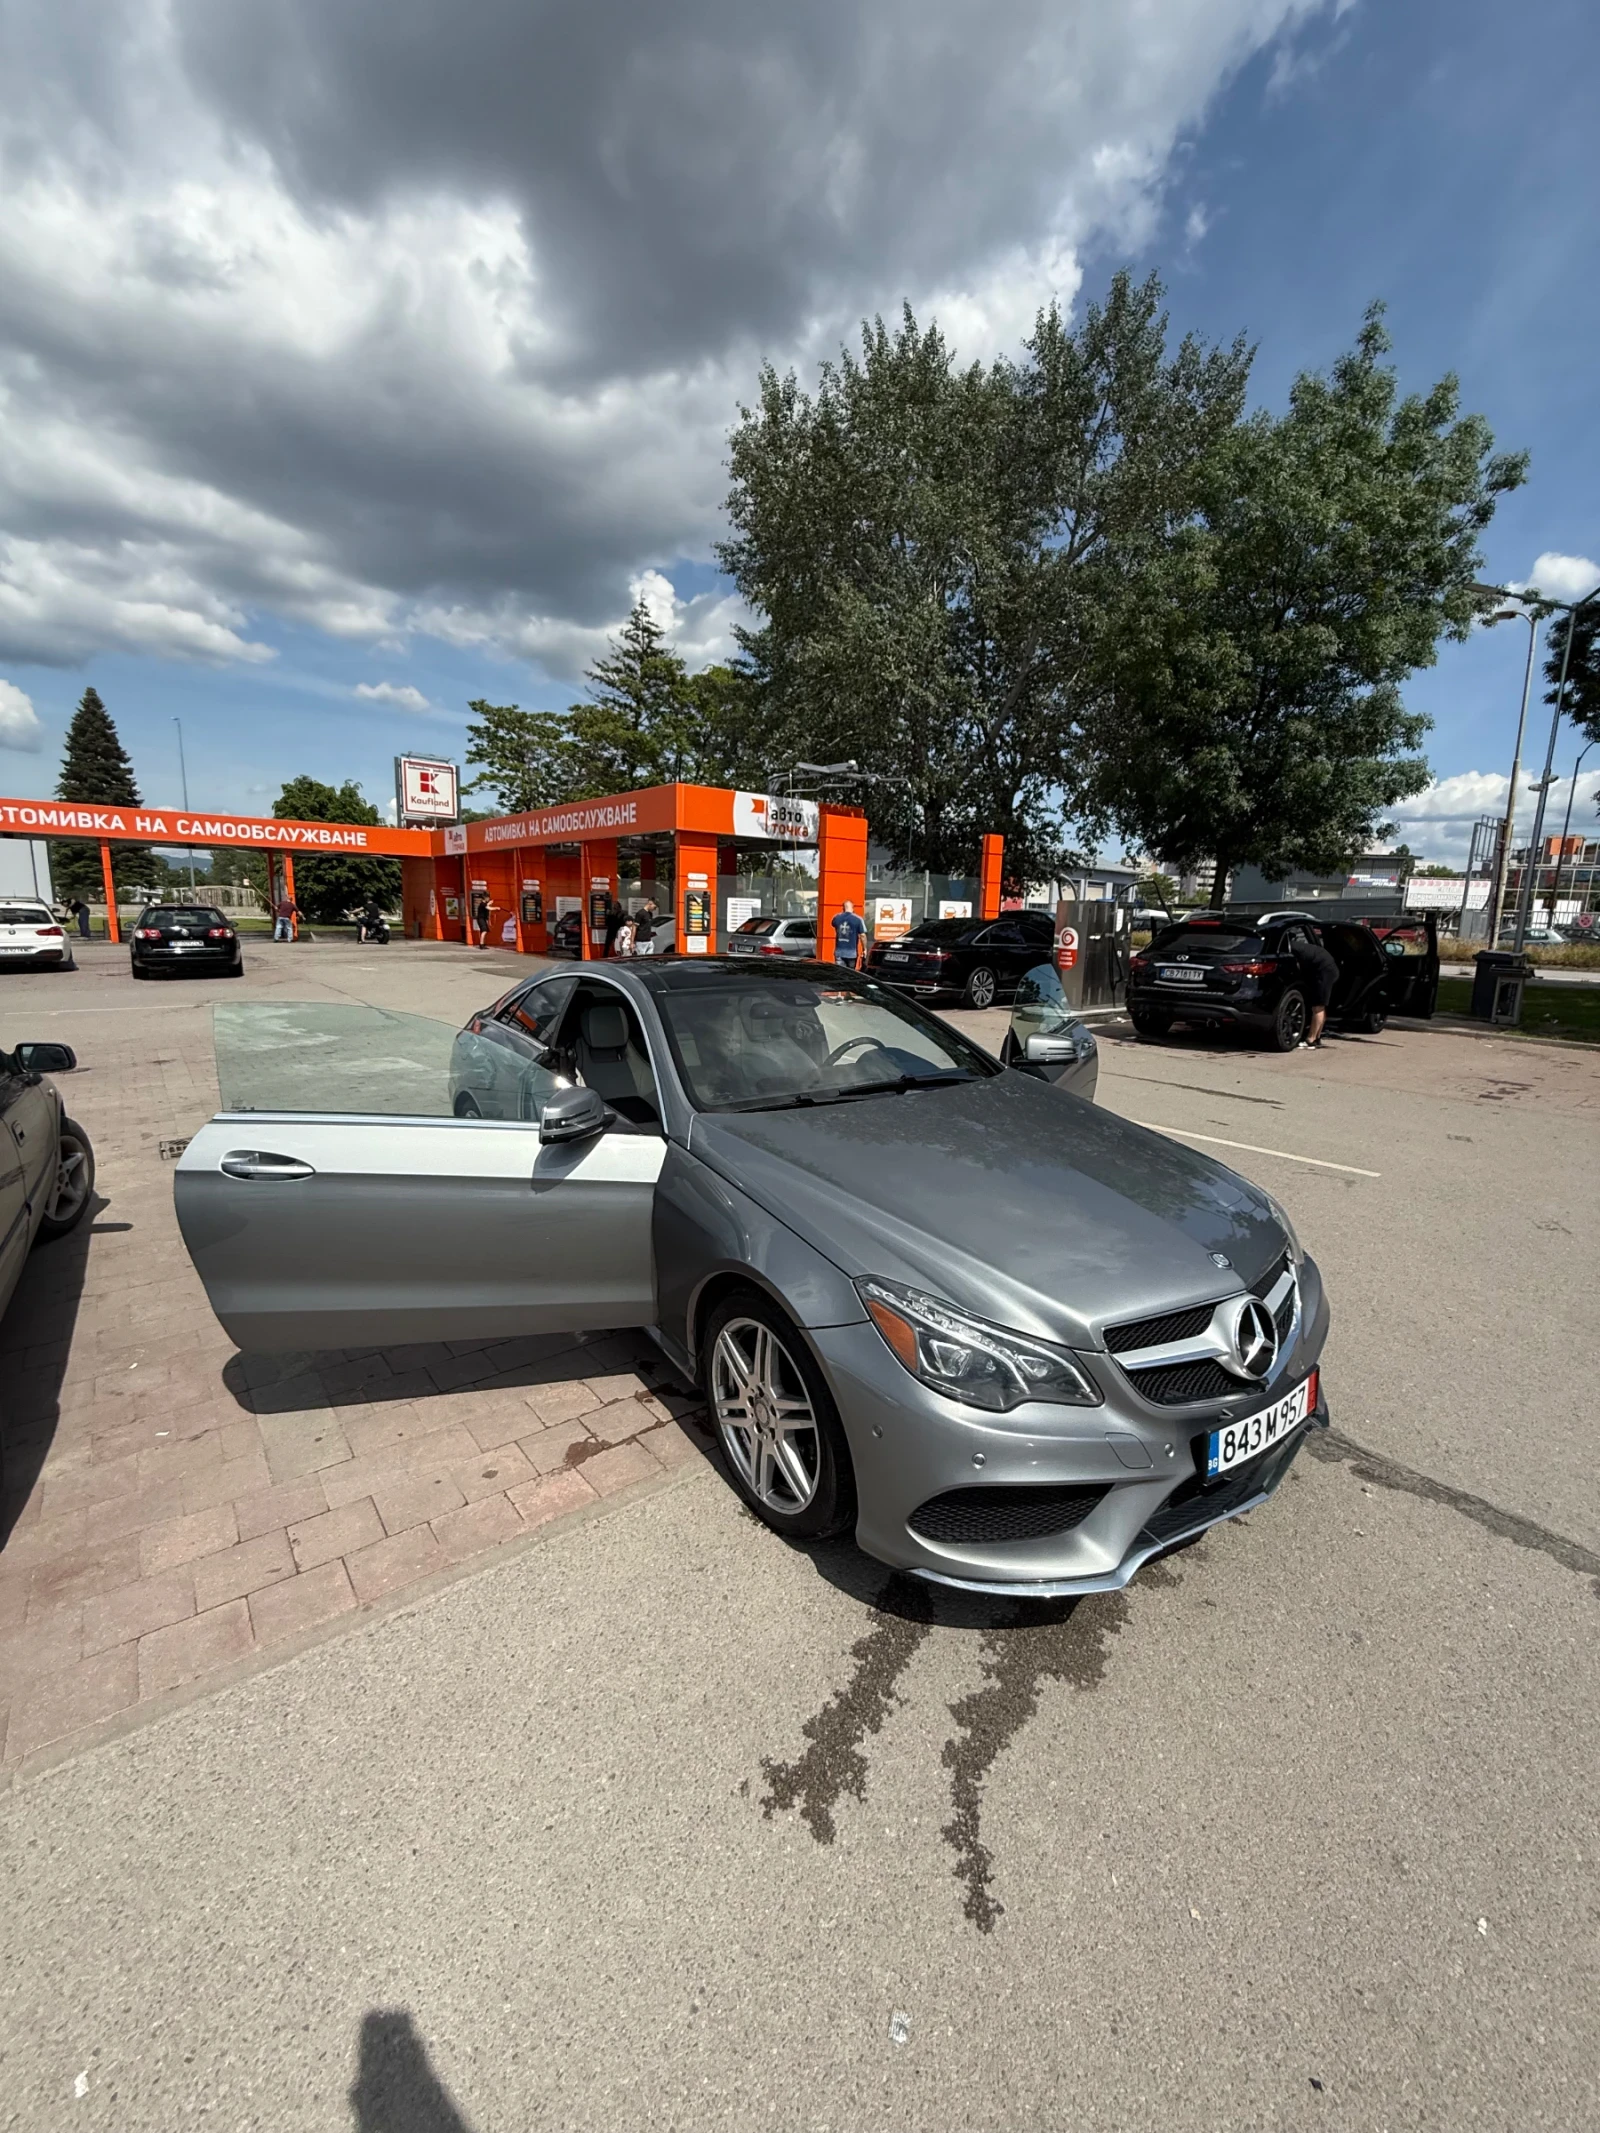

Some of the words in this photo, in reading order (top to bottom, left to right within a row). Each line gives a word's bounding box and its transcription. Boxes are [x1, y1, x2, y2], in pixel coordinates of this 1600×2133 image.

[411, 796, 449, 807] Kaufland
[136, 816, 168, 833] НА
[177, 819, 367, 846] САМООБСЛУЖВАНЕ
[484, 822, 527, 843] АВТОМИВКА
[529, 820, 541, 837] НА
[542, 802, 637, 835] САМООБСЛУЖВАНЕ
[772, 824, 809, 837] точка
